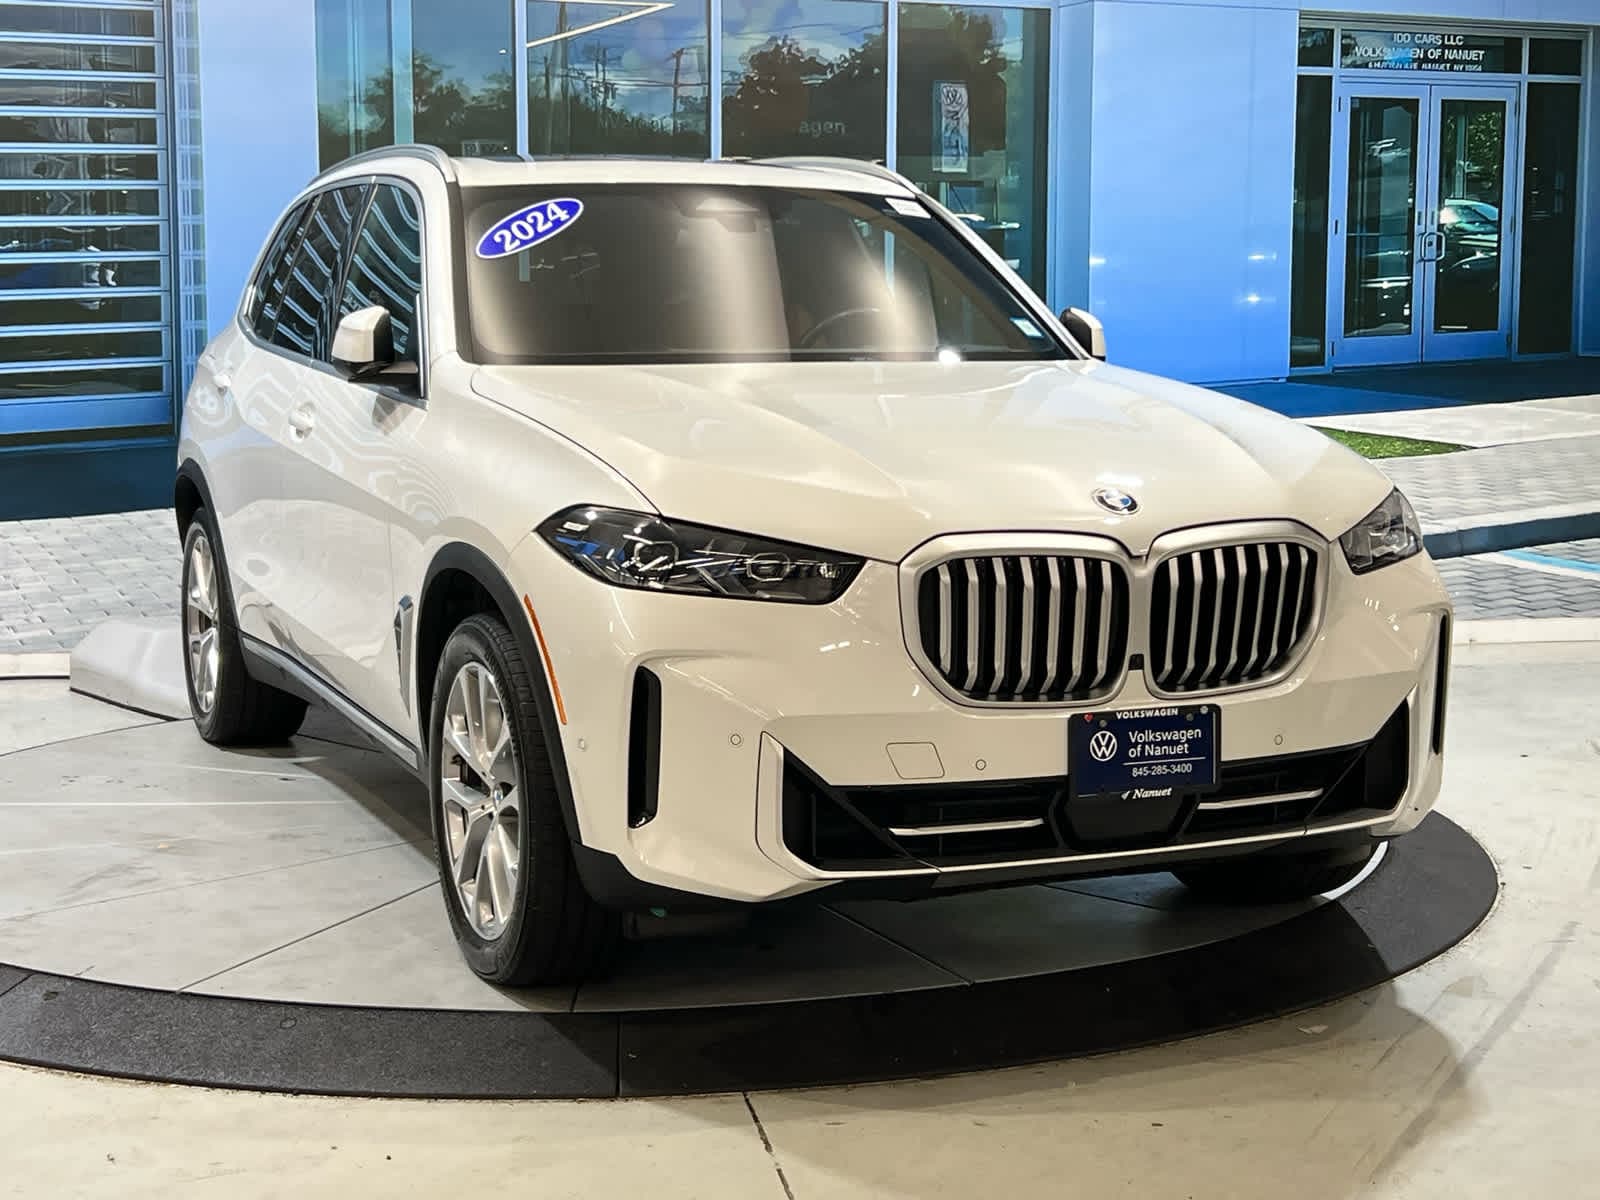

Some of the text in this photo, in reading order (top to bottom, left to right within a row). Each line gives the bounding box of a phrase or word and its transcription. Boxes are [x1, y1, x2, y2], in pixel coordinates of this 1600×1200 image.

[1414, 33, 1442, 45] CARS
[1444, 34, 1465, 46] LLC
[1427, 48, 1442, 60] OF
[1444, 49, 1486, 61] NANUET
[493, 202, 571, 252] 2024
[1116, 708, 1179, 720] VOLKSWAGEN
[1128, 728, 1202, 743] Volkswagen
[1128, 743, 1190, 758] of Nanuet
[1132, 763, 1193, 778] 845-285-3400
[1132, 787, 1173, 800] Nanuet
